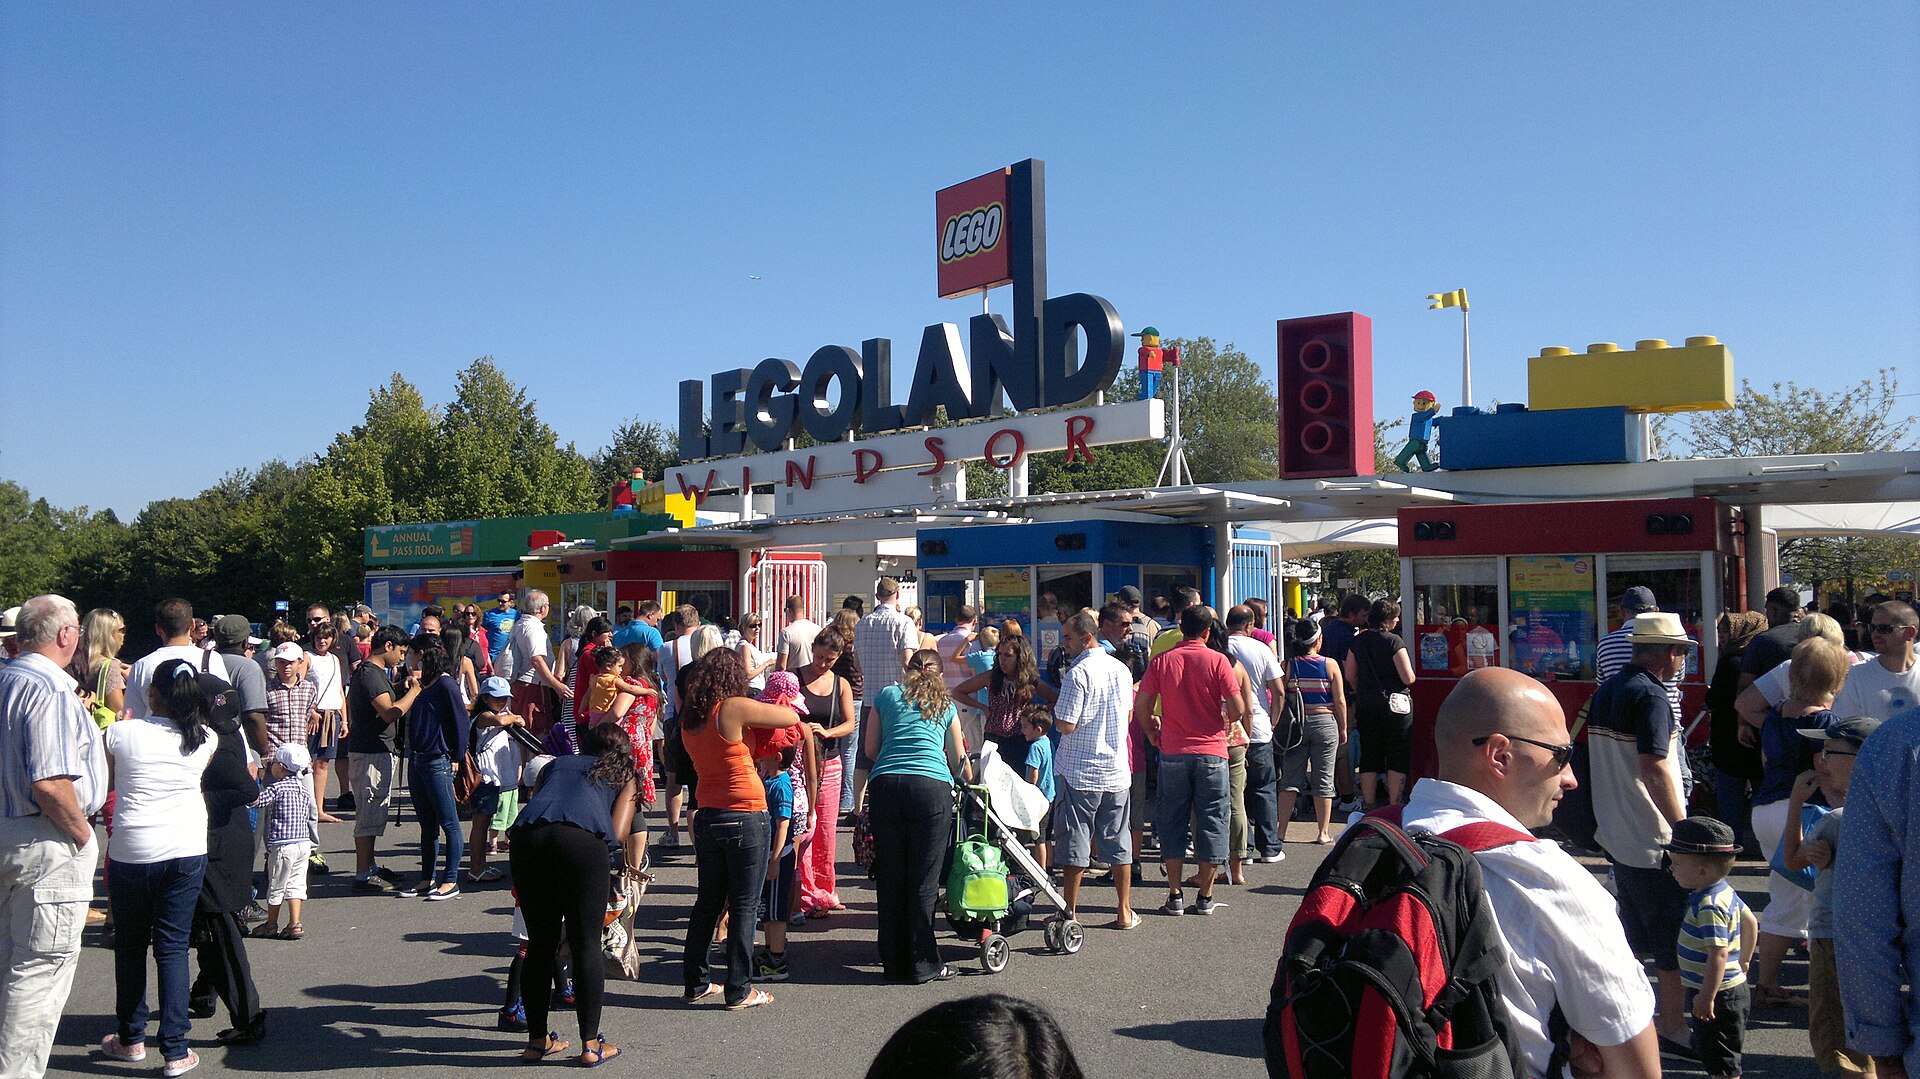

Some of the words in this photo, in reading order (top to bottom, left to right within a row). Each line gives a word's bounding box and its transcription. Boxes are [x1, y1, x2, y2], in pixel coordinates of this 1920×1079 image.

[942, 204, 1003, 262] LEGO
[678, 158, 1125, 460] LEGOLAND
[676, 415, 1096, 505] WINDSOR
[393, 532, 432, 543] ANNUAL
[393, 546, 413, 556] PASS
[415, 545, 444, 555] ROOM
